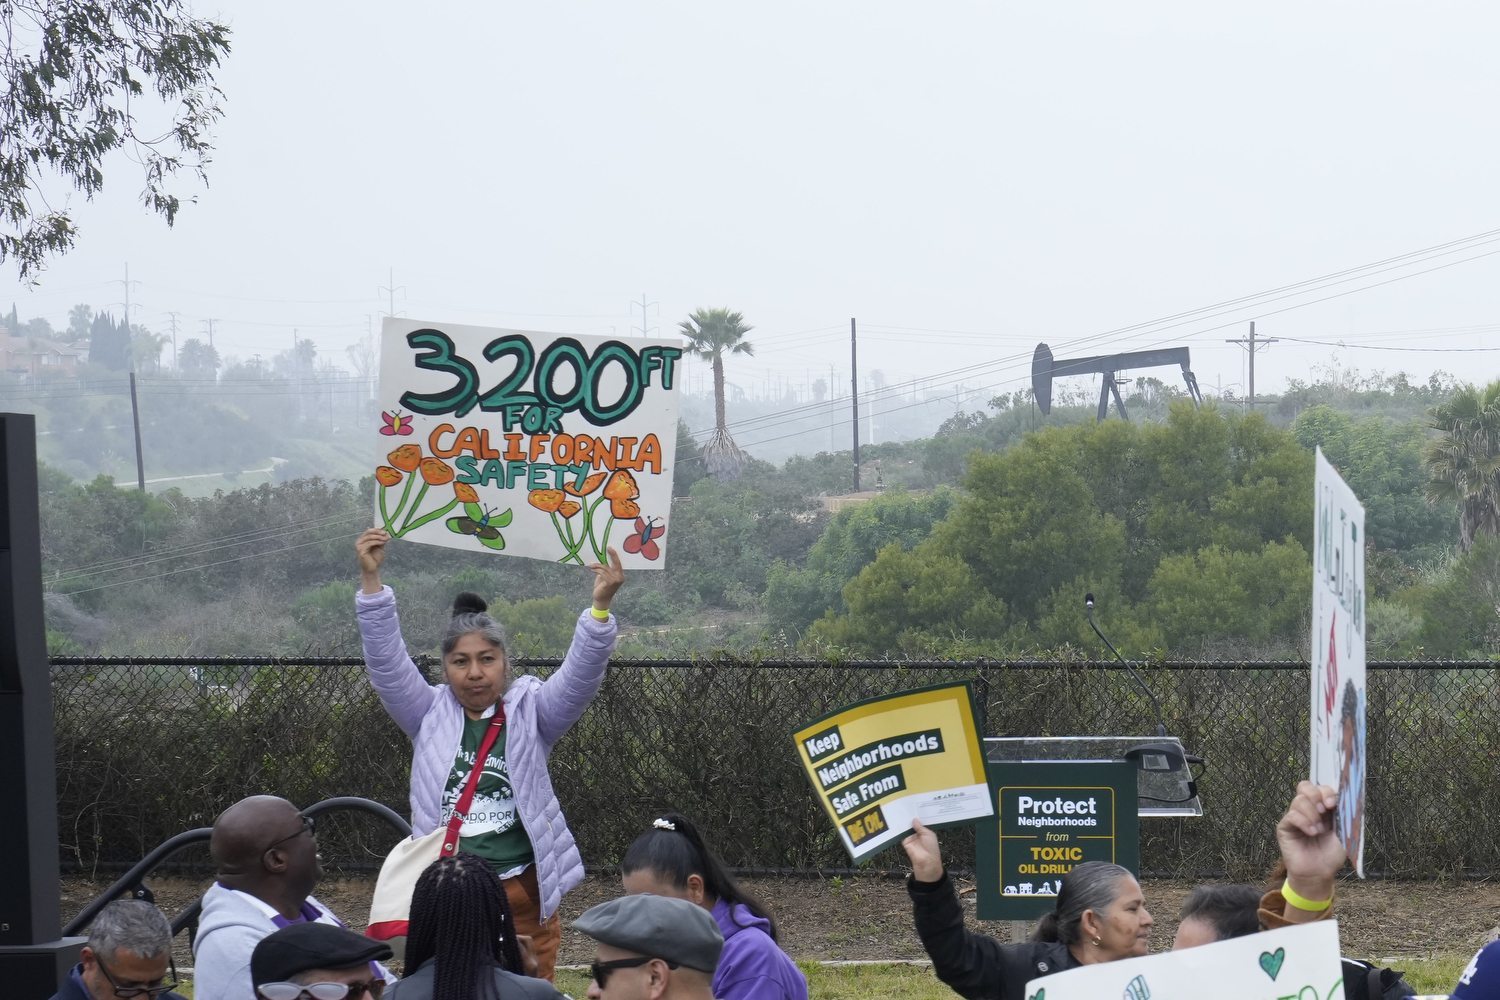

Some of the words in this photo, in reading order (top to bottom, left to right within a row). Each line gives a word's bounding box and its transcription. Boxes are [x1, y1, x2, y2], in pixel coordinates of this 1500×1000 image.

[400, 328, 645, 427] 3,200
[502, 404, 564, 434] FOR
[428, 423, 663, 475] CALIFORNIA
[455, 455, 590, 492] SAFETY
[805, 731, 841, 758] Keep
[817, 733, 939, 788] Neighborhoods
[831, 793, 861, 815] Safe
[858, 774, 900, 803] From
[1018, 796, 1097, 815] Protect
[1017, 816, 1098, 828] Neighborhoods
[1045, 831, 1070, 842] from
[1030, 847, 1083, 861] TOXIC
[1018, 863, 1039, 874] OIL
